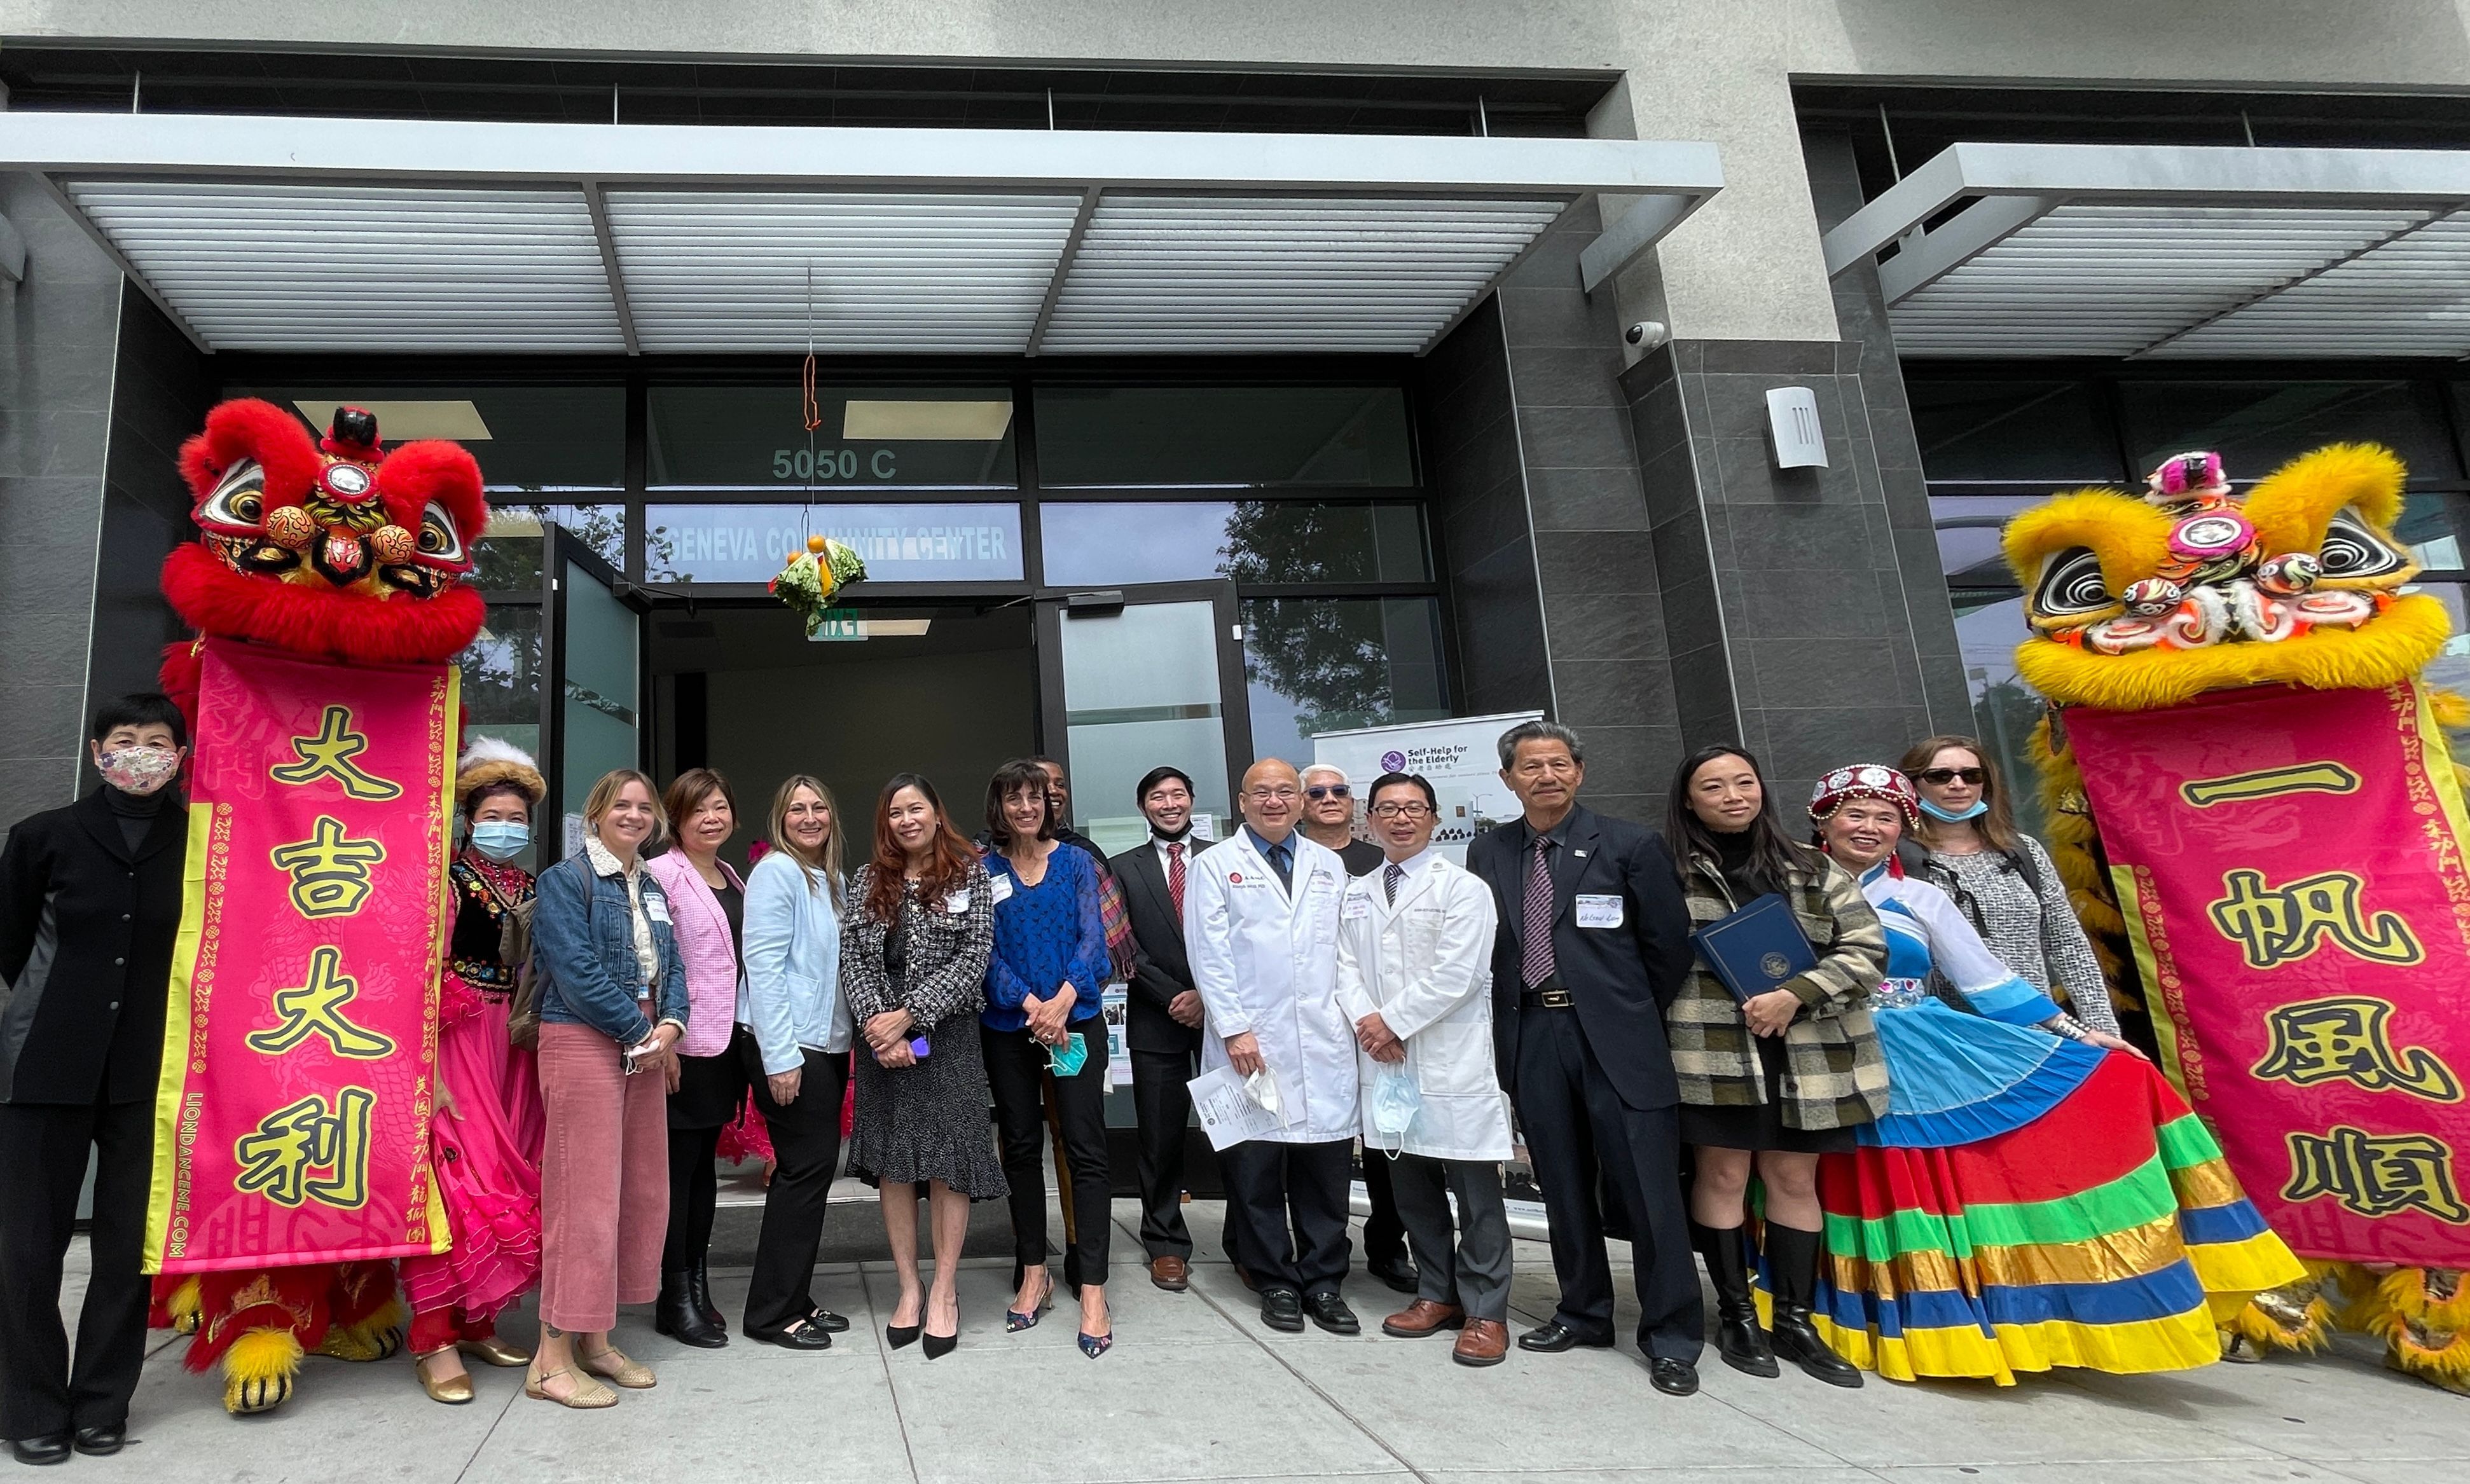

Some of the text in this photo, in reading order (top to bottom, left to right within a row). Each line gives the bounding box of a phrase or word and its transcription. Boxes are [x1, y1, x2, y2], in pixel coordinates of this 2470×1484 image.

[772, 449, 897, 479] 5050 C
[663, 526, 759, 561] GENEVA
[916, 526, 1007, 561] CENTER
[1407, 746, 1452, 757] Self-Help
[1408, 755, 1459, 765] the Elderly
[234, 704, 403, 1209] 大吉大利
[168, 1092, 204, 1258] LIONDANCEME.COM
